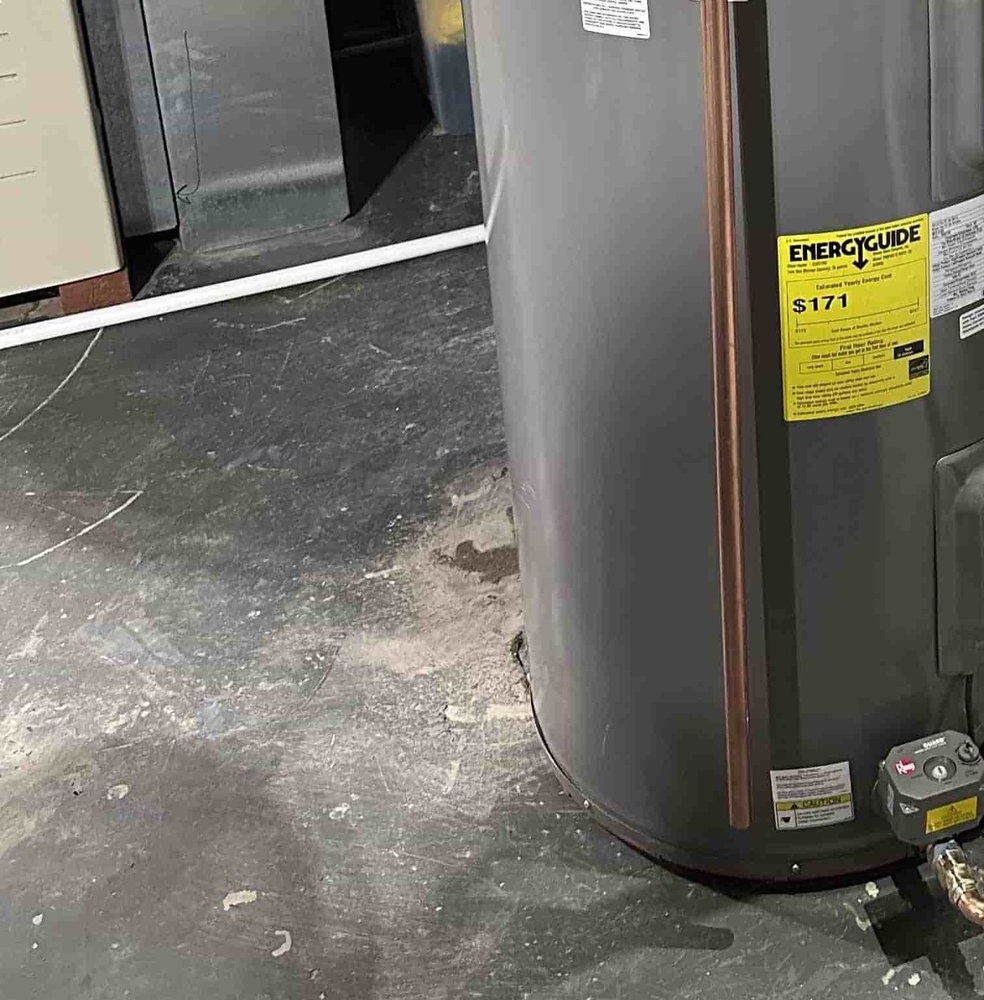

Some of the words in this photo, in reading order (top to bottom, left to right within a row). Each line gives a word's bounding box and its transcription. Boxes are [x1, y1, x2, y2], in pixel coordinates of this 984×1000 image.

[790, 224, 921, 263] ENERGYGUIDE
[816, 280, 842, 291] Estimated
[844, 278, 861, 290] Yearly
[862, 276, 880, 286] Energy
[880, 273, 892, 281] Cost
[792, 293, 848, 314] $171
[802, 795, 840, 808] CAUTION
